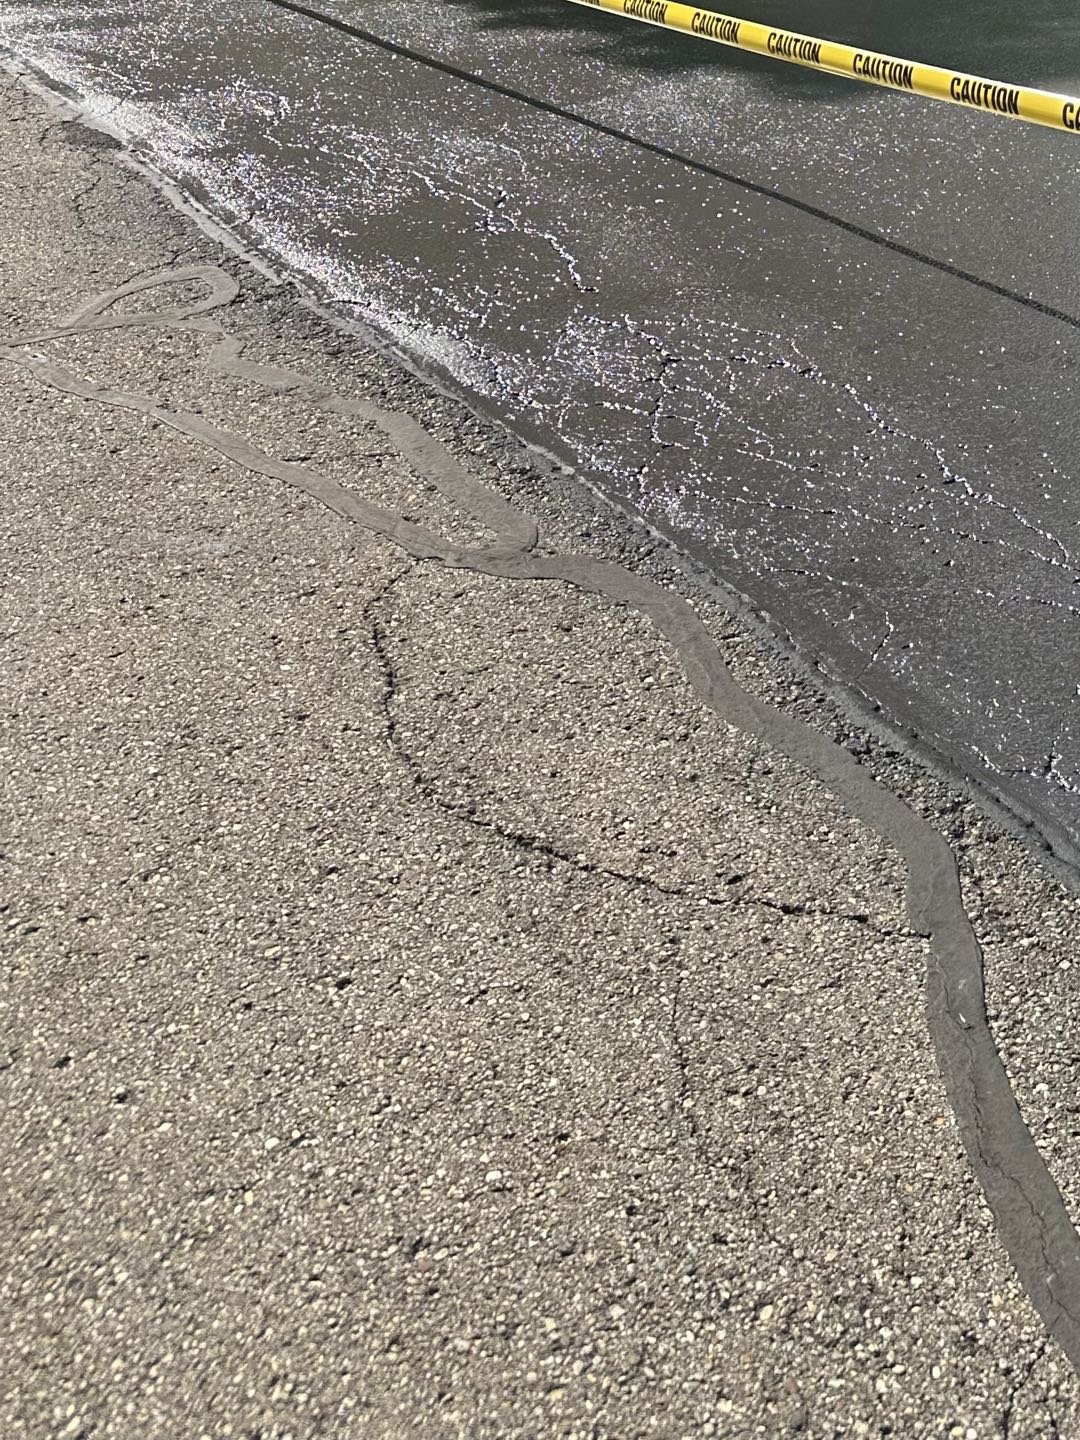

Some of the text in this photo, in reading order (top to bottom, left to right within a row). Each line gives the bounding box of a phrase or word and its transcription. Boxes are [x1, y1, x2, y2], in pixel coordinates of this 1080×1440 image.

[691, 12, 740, 45] CAUTION
[767, 32, 821, 64] CAUTION
[852, 54, 913, 90] CAUTION
[950, 77, 1019, 115] CAUTION
